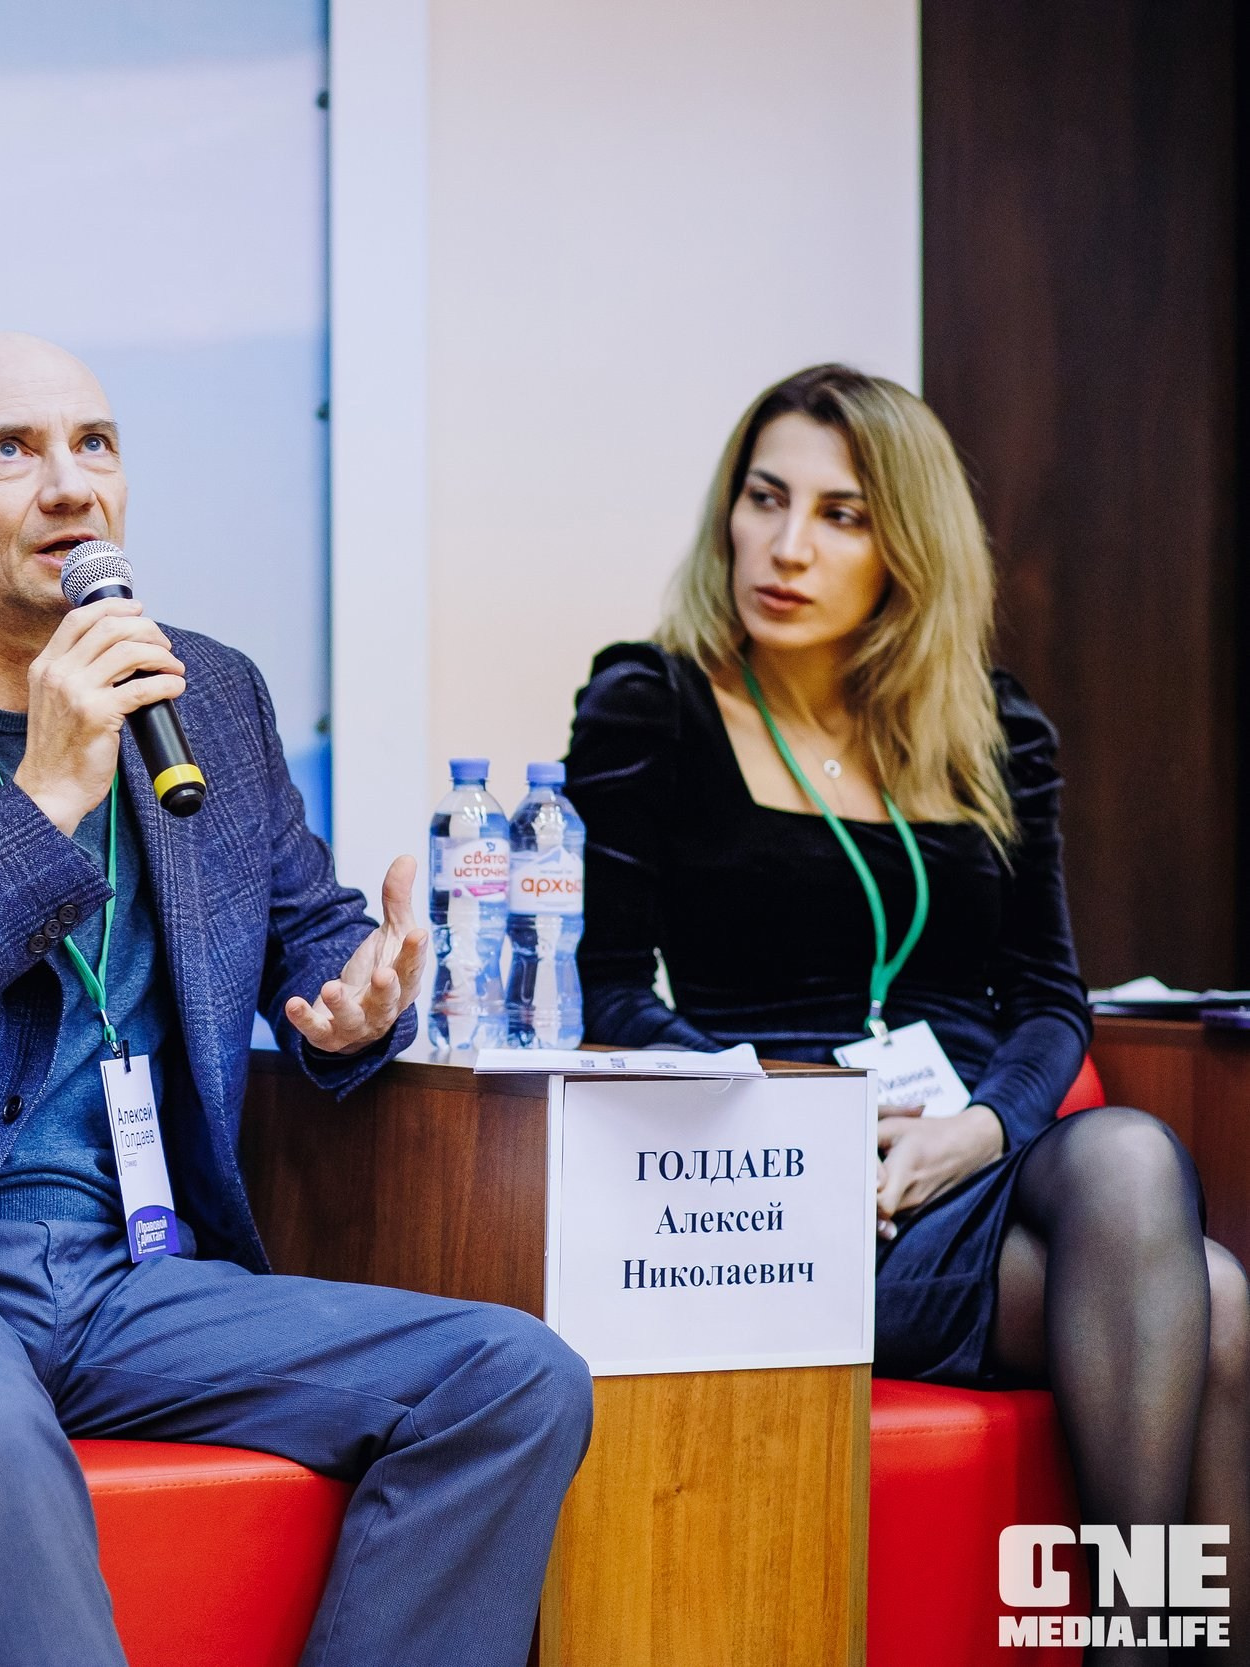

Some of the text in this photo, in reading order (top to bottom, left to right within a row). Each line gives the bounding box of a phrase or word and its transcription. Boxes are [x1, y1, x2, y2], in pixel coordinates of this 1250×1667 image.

[118, 1102, 153, 1125] Алексей
[120, 1129, 155, 1150] Голдаев
[635, 1148, 805, 1186] ГОЛДАЕВ
[655, 1201, 784, 1235] Алексей
[622, 1258, 814, 1290] Николаевич
